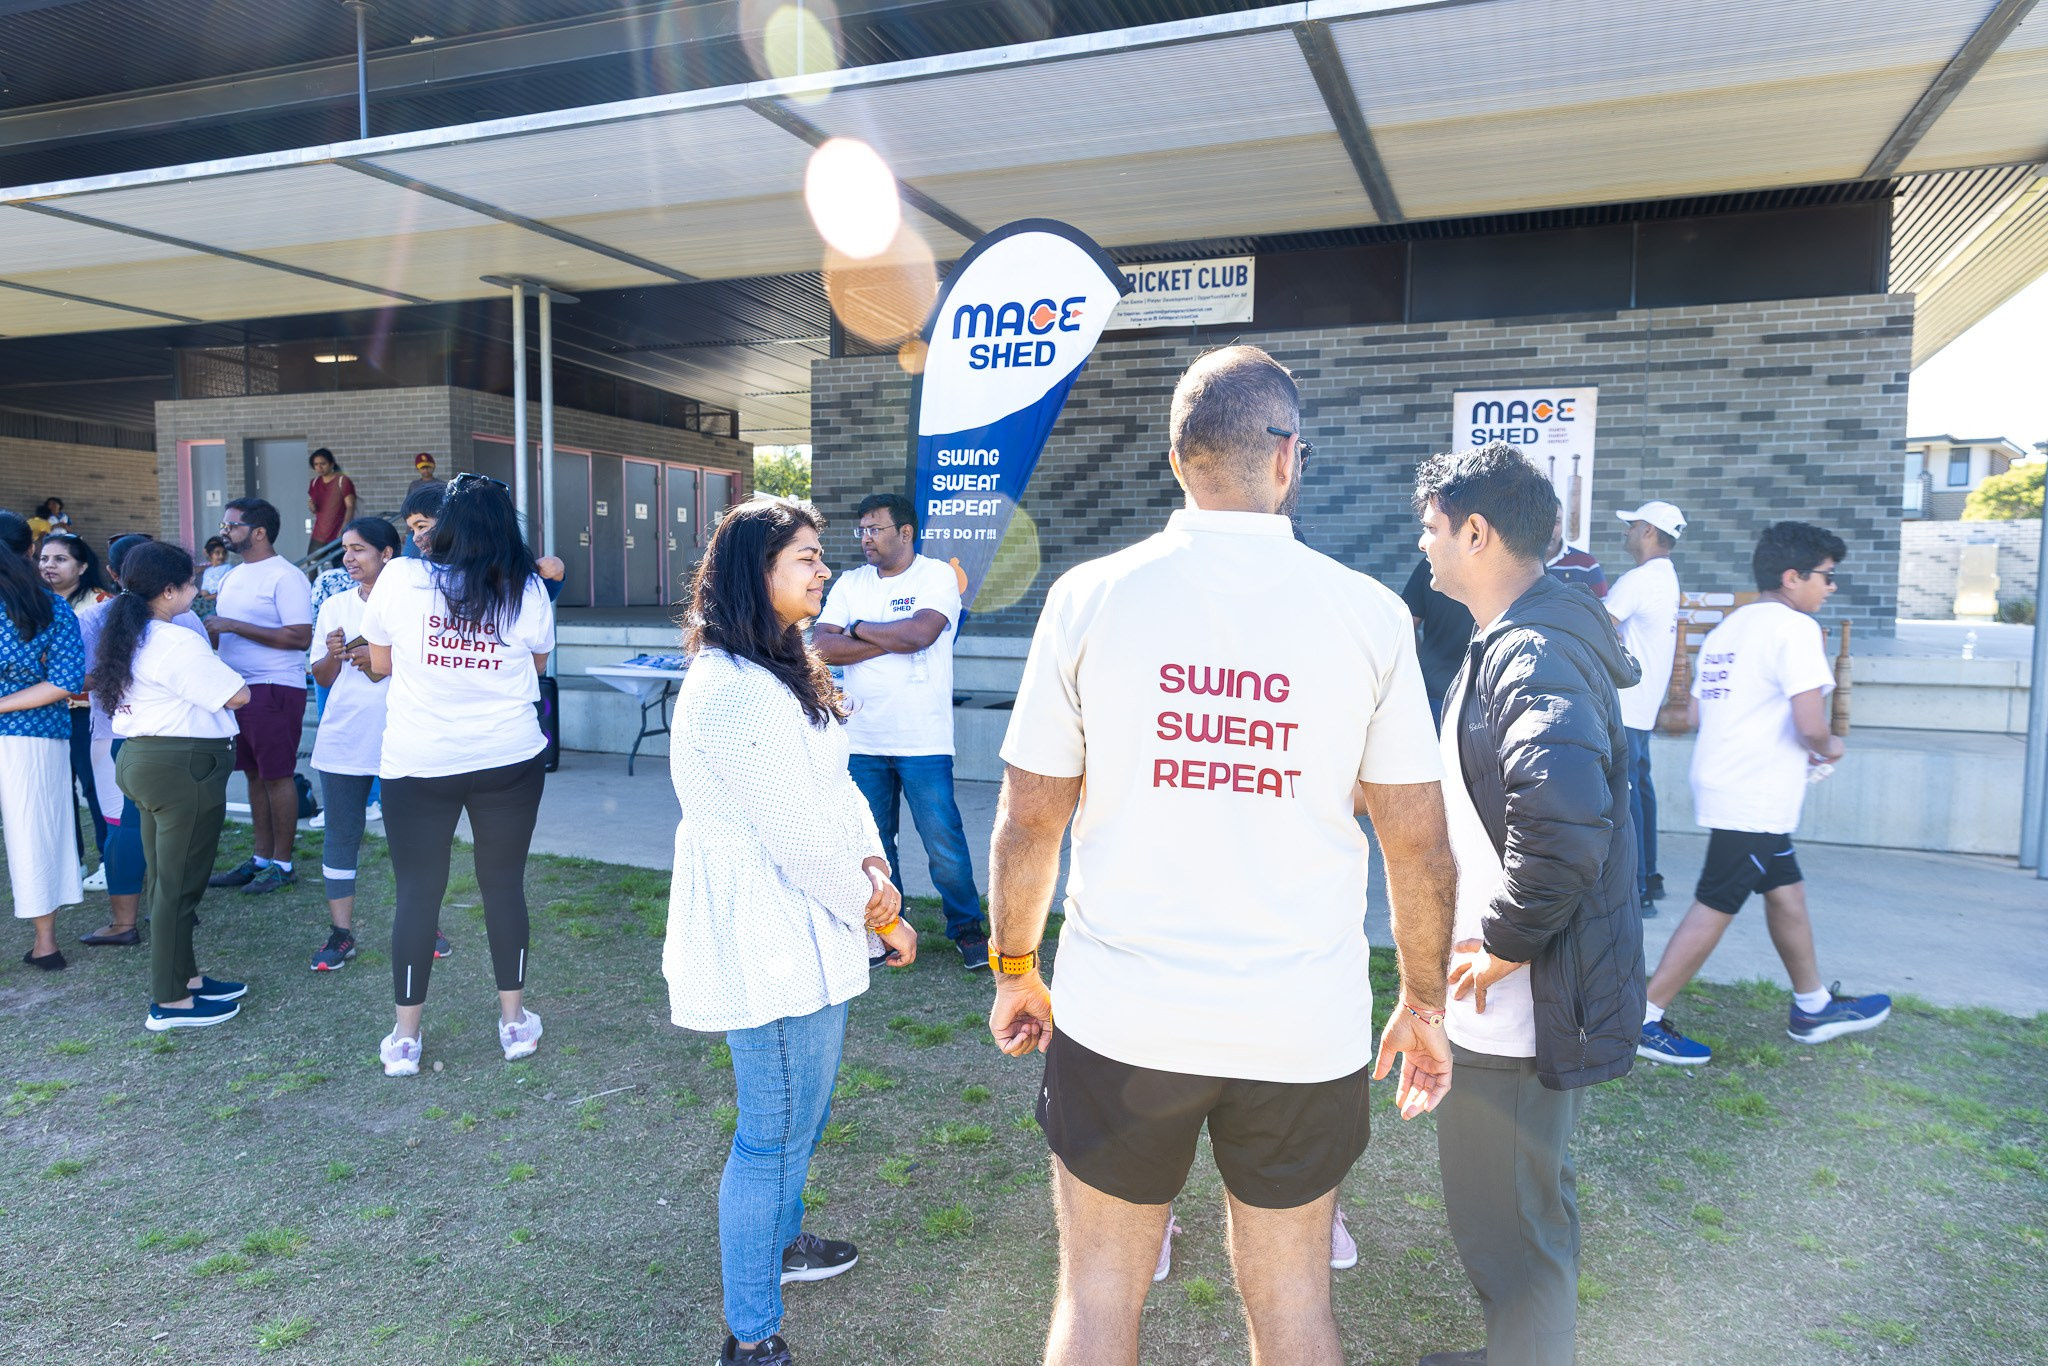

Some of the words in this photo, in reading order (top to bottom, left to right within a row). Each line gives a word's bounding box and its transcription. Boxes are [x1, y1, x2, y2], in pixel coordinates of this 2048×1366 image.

[1125, 268, 1193, 293] RICKET
[1197, 264, 1249, 289] CLUB
[952, 296, 1087, 339] MACE
[968, 340, 1056, 370] SHED
[1472, 398, 1576, 424] MACE
[1471, 427, 1539, 446] SHED
[937, 448, 1000, 466] SWING
[932, 473, 1001, 491] SWEAT
[928, 499, 1002, 516] REPEAT
[953, 528, 972, 540] DO
[974, 528, 997, 540] IT!!!
[890, 597, 916, 606] MACE
[428, 615, 496, 635] SWING
[428, 635, 500, 654] SWEAT
[427, 653, 503, 671] REPEAT
[1159, 663, 1290, 703] SWING
[1156, 711, 1299, 752] SWEAT
[1153, 758, 1302, 799] REPEAT
